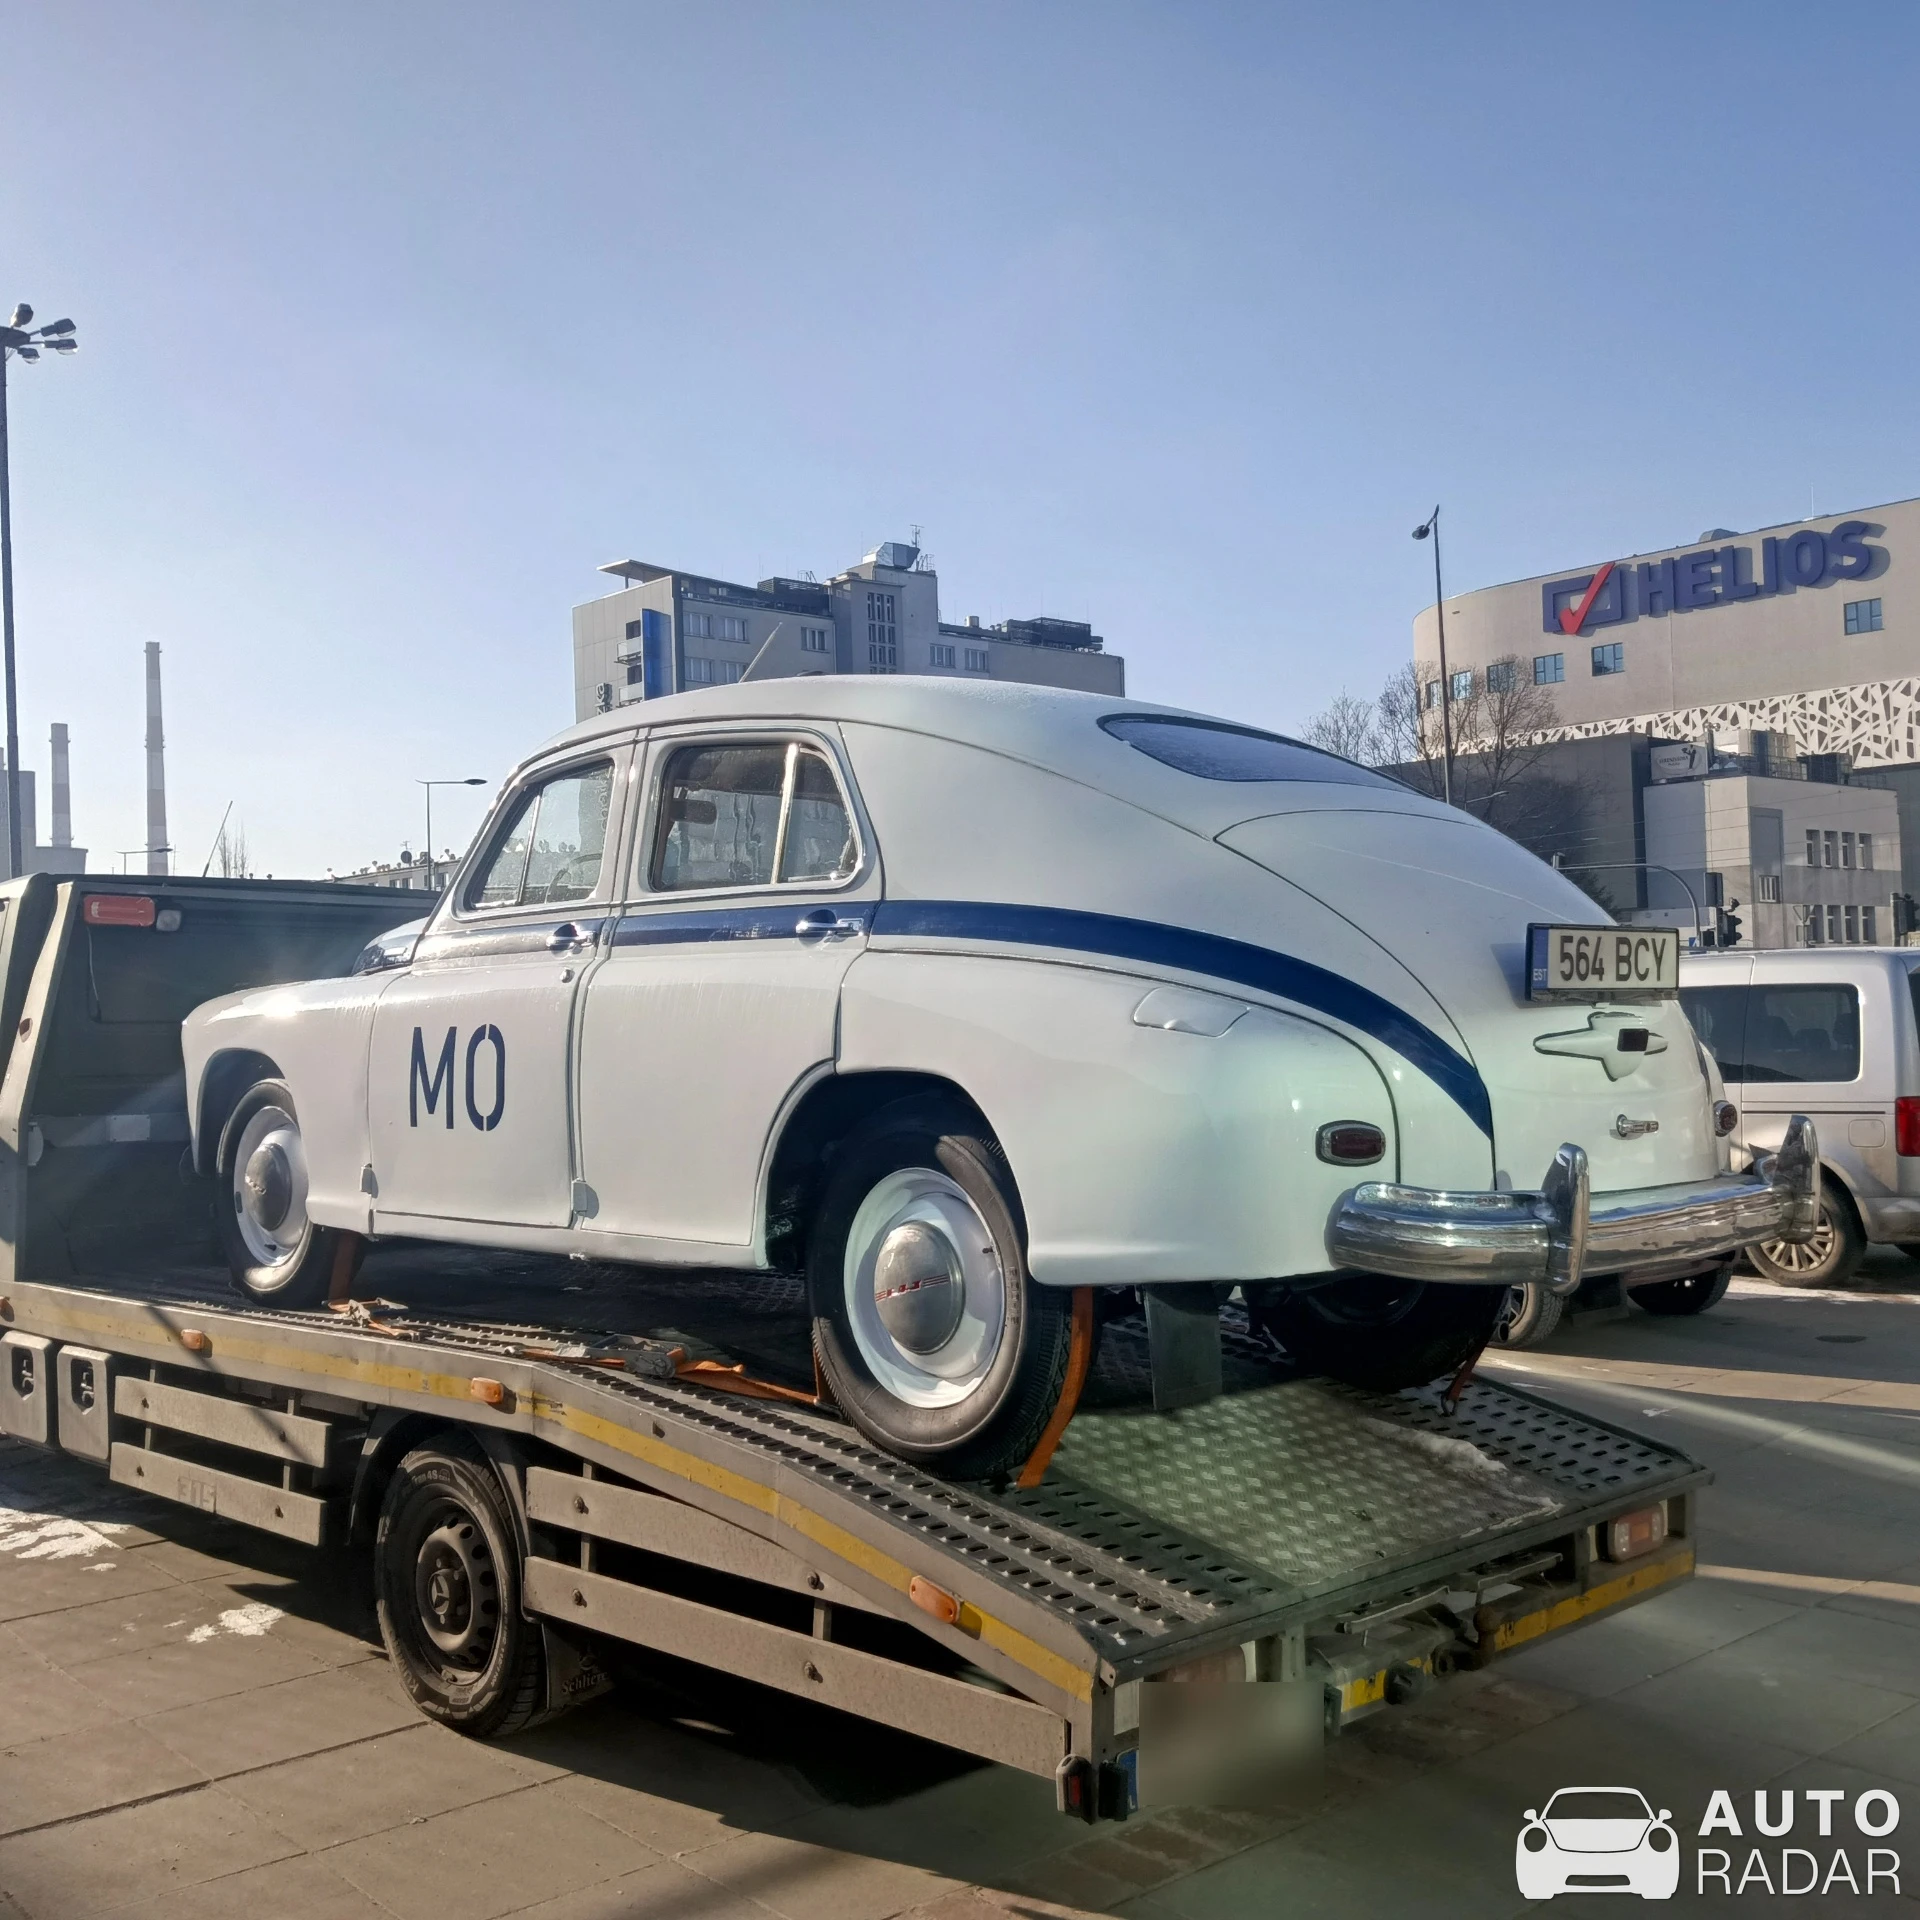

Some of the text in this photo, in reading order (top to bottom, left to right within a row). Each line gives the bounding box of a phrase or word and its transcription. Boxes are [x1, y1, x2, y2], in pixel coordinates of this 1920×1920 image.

[1638, 520, 1871, 616] HELIOS
[1533, 968, 1547, 981] EST
[1560, 935, 1666, 982] 564 BCY
[409, 1023, 505, 1131] MO
